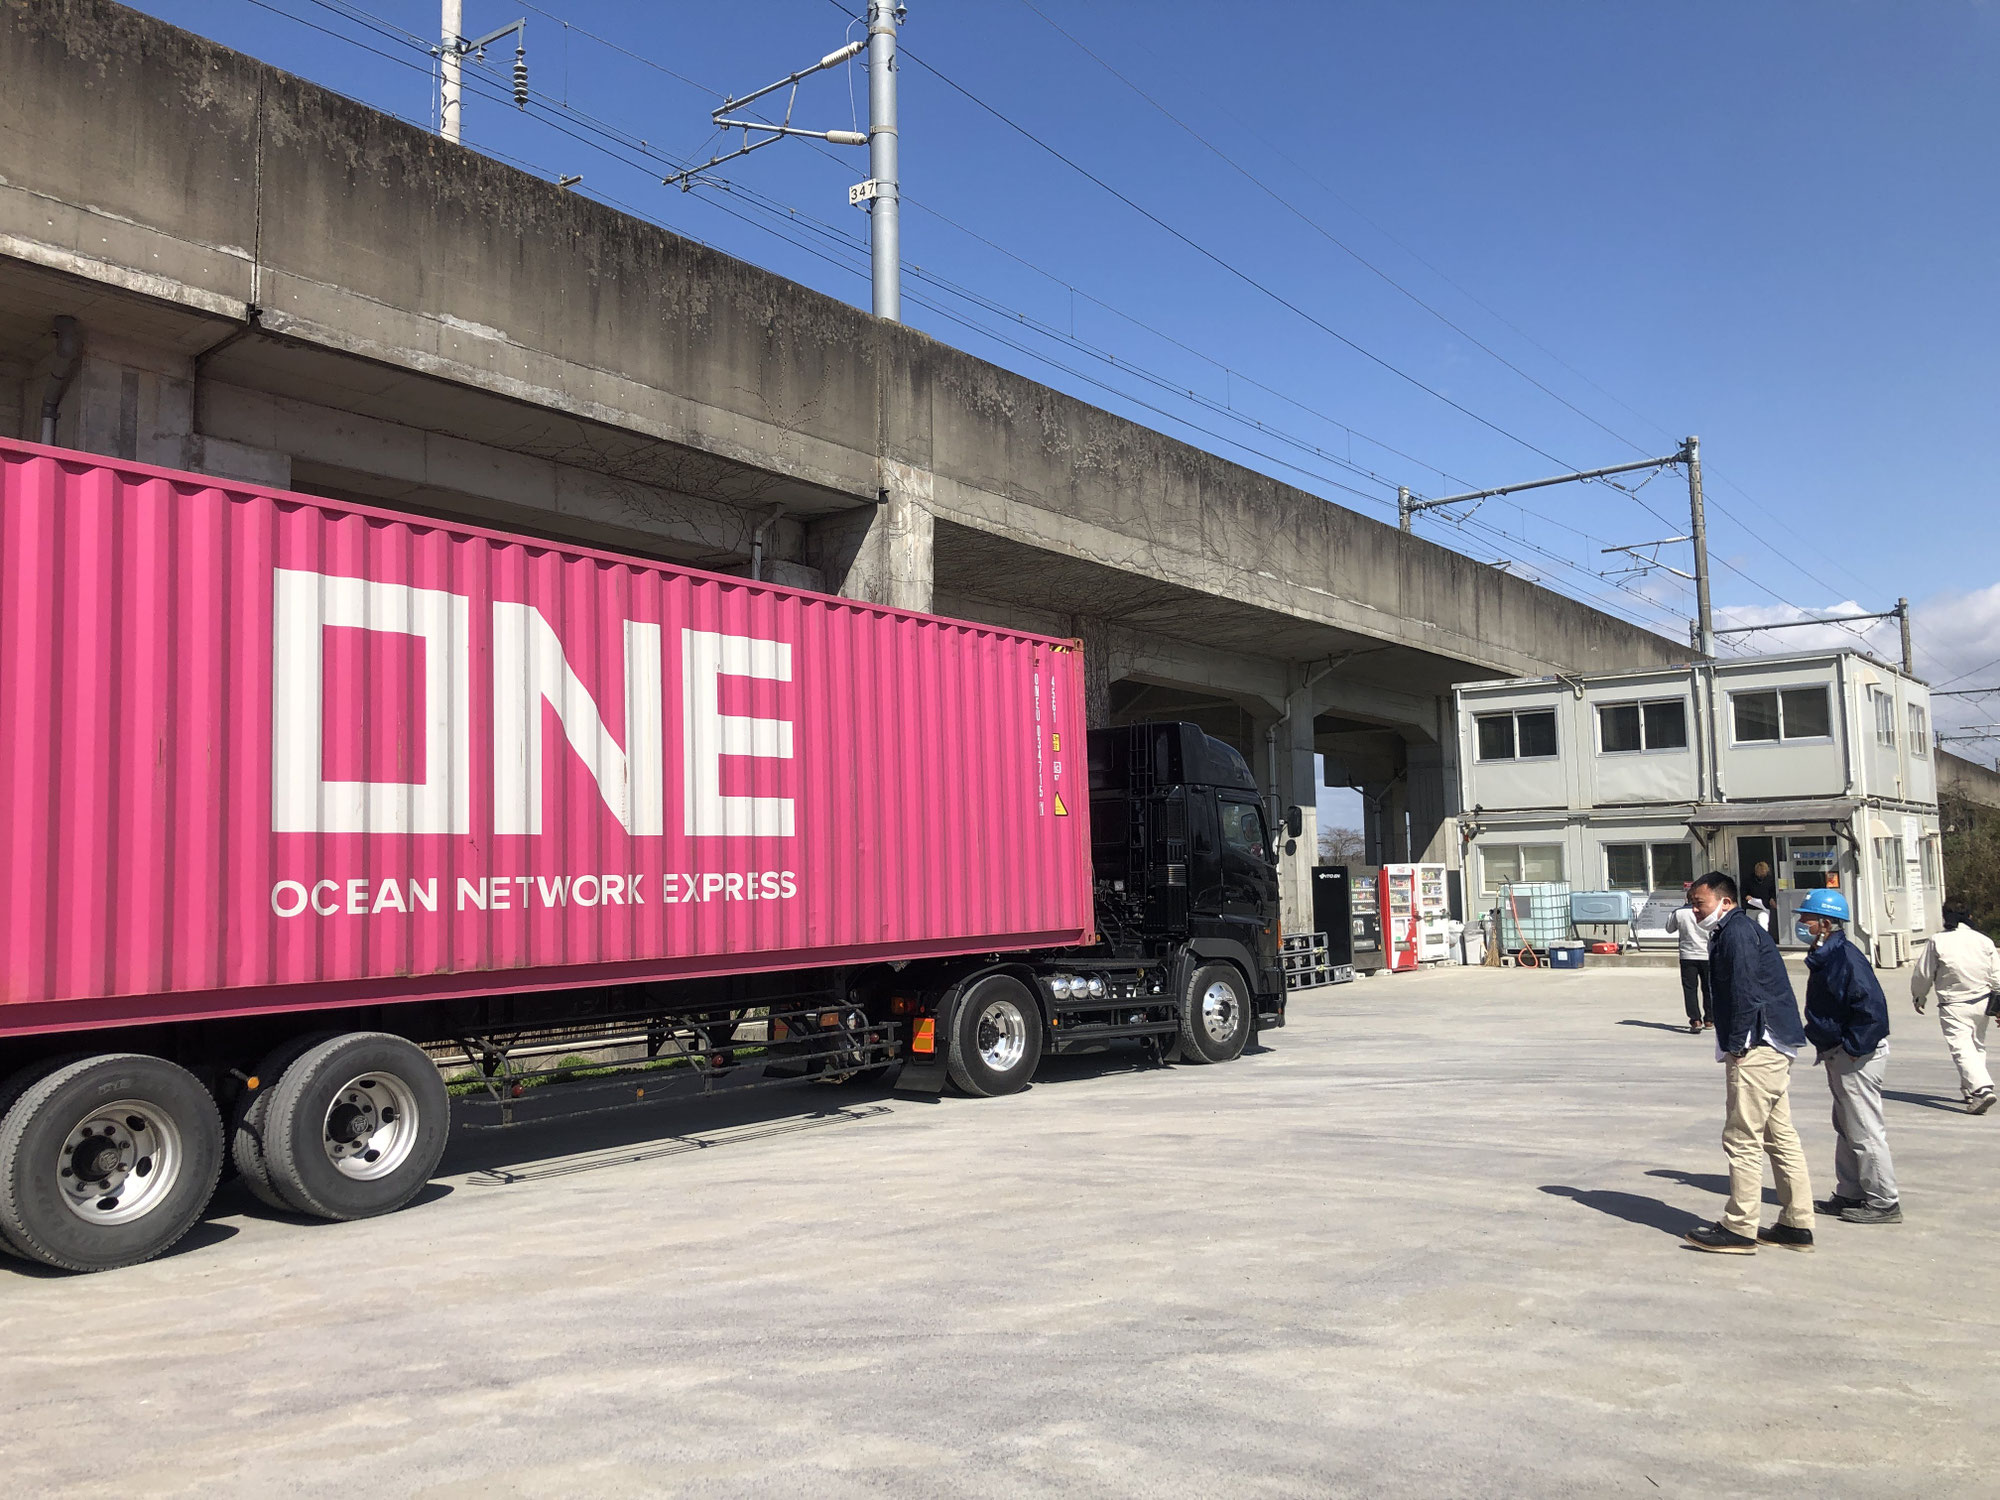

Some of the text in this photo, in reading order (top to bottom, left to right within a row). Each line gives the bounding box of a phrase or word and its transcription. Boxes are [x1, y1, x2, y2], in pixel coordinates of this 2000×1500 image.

[851, 183, 874, 200] 347
[271, 566, 796, 837] ONE
[271, 870, 798, 918] OCEAN NETWORK EXPRESS
